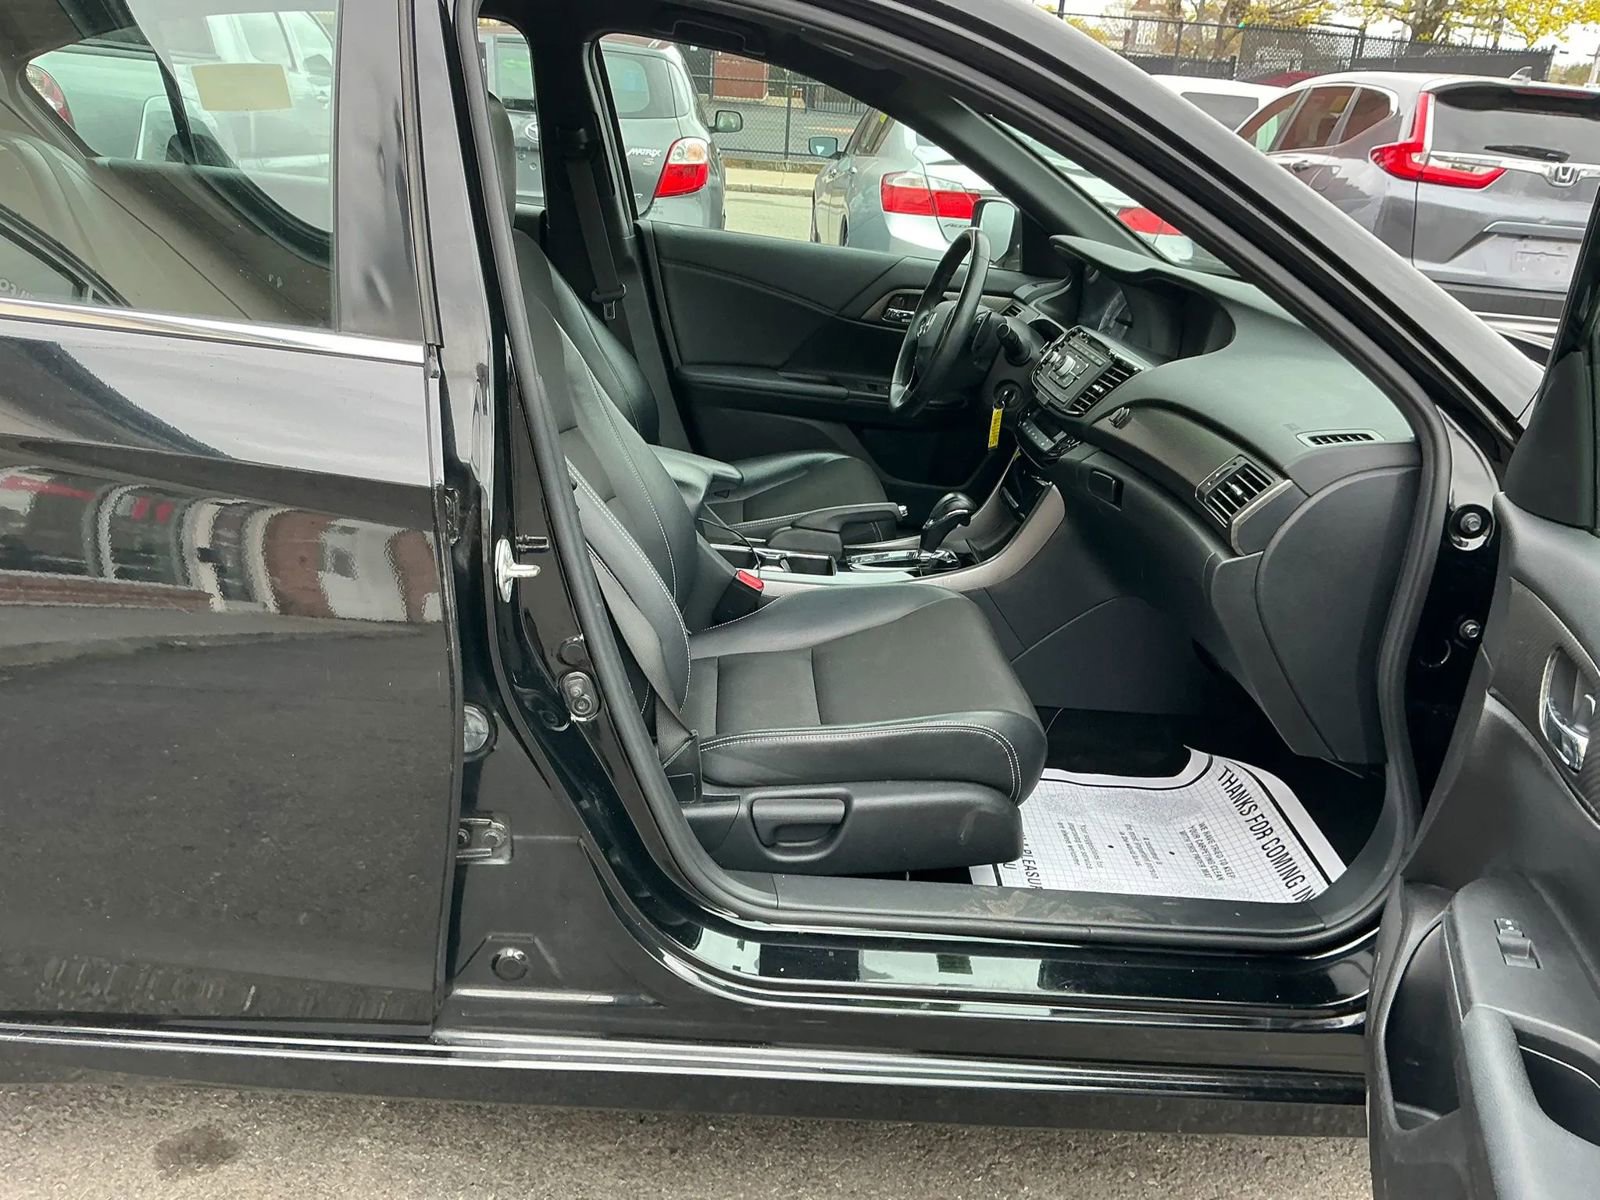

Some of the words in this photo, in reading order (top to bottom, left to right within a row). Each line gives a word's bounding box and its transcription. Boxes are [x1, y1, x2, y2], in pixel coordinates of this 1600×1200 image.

[1218, 766, 1258, 816] THANKS
[1245, 813, 1274, 840] FOR
[1261, 837, 1306, 889] COMING
